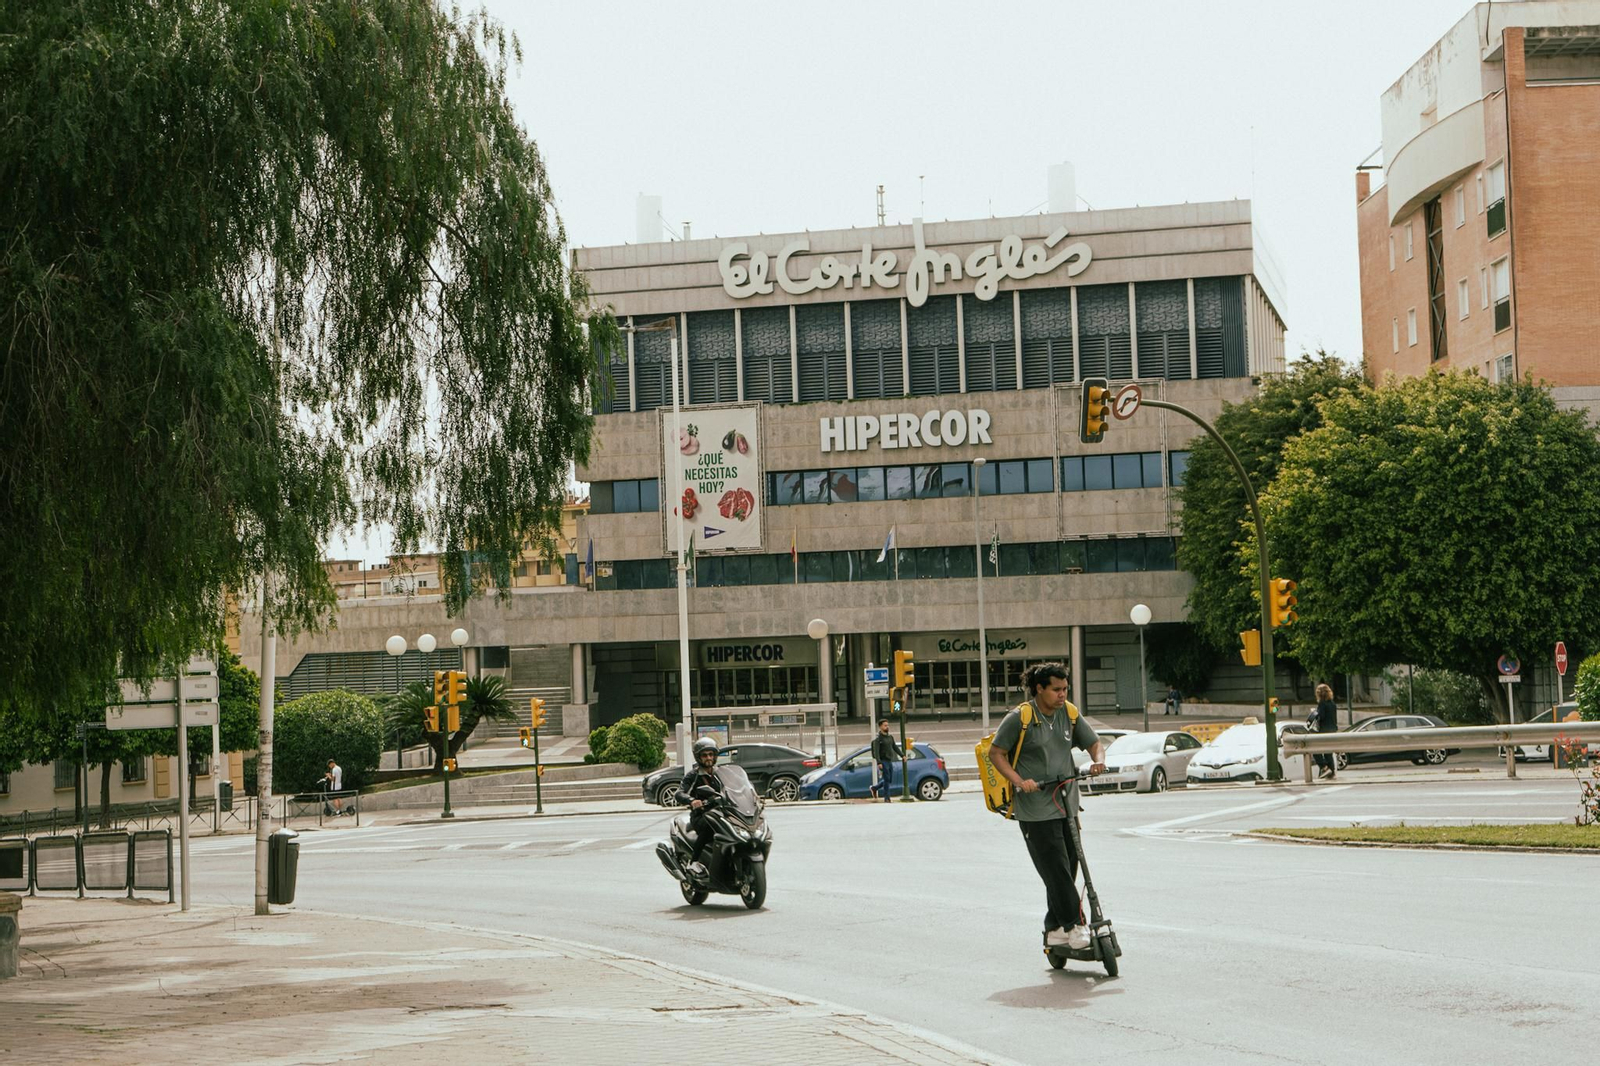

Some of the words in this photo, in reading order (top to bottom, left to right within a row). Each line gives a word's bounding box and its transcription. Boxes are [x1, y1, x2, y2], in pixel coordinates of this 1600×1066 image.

[718, 242, 774, 299] El
[775, 240, 900, 295] Corte
[906, 217, 1092, 307] Inglés
[820, 409, 993, 452] HIPERCOR
[698, 450, 723, 467] ¿QUÉ
[685, 466, 738, 480] NECESITAS
[699, 481, 724, 493] HOY?
[707, 644, 784, 662] HIPERCOR
[939, 639, 951, 652] El
